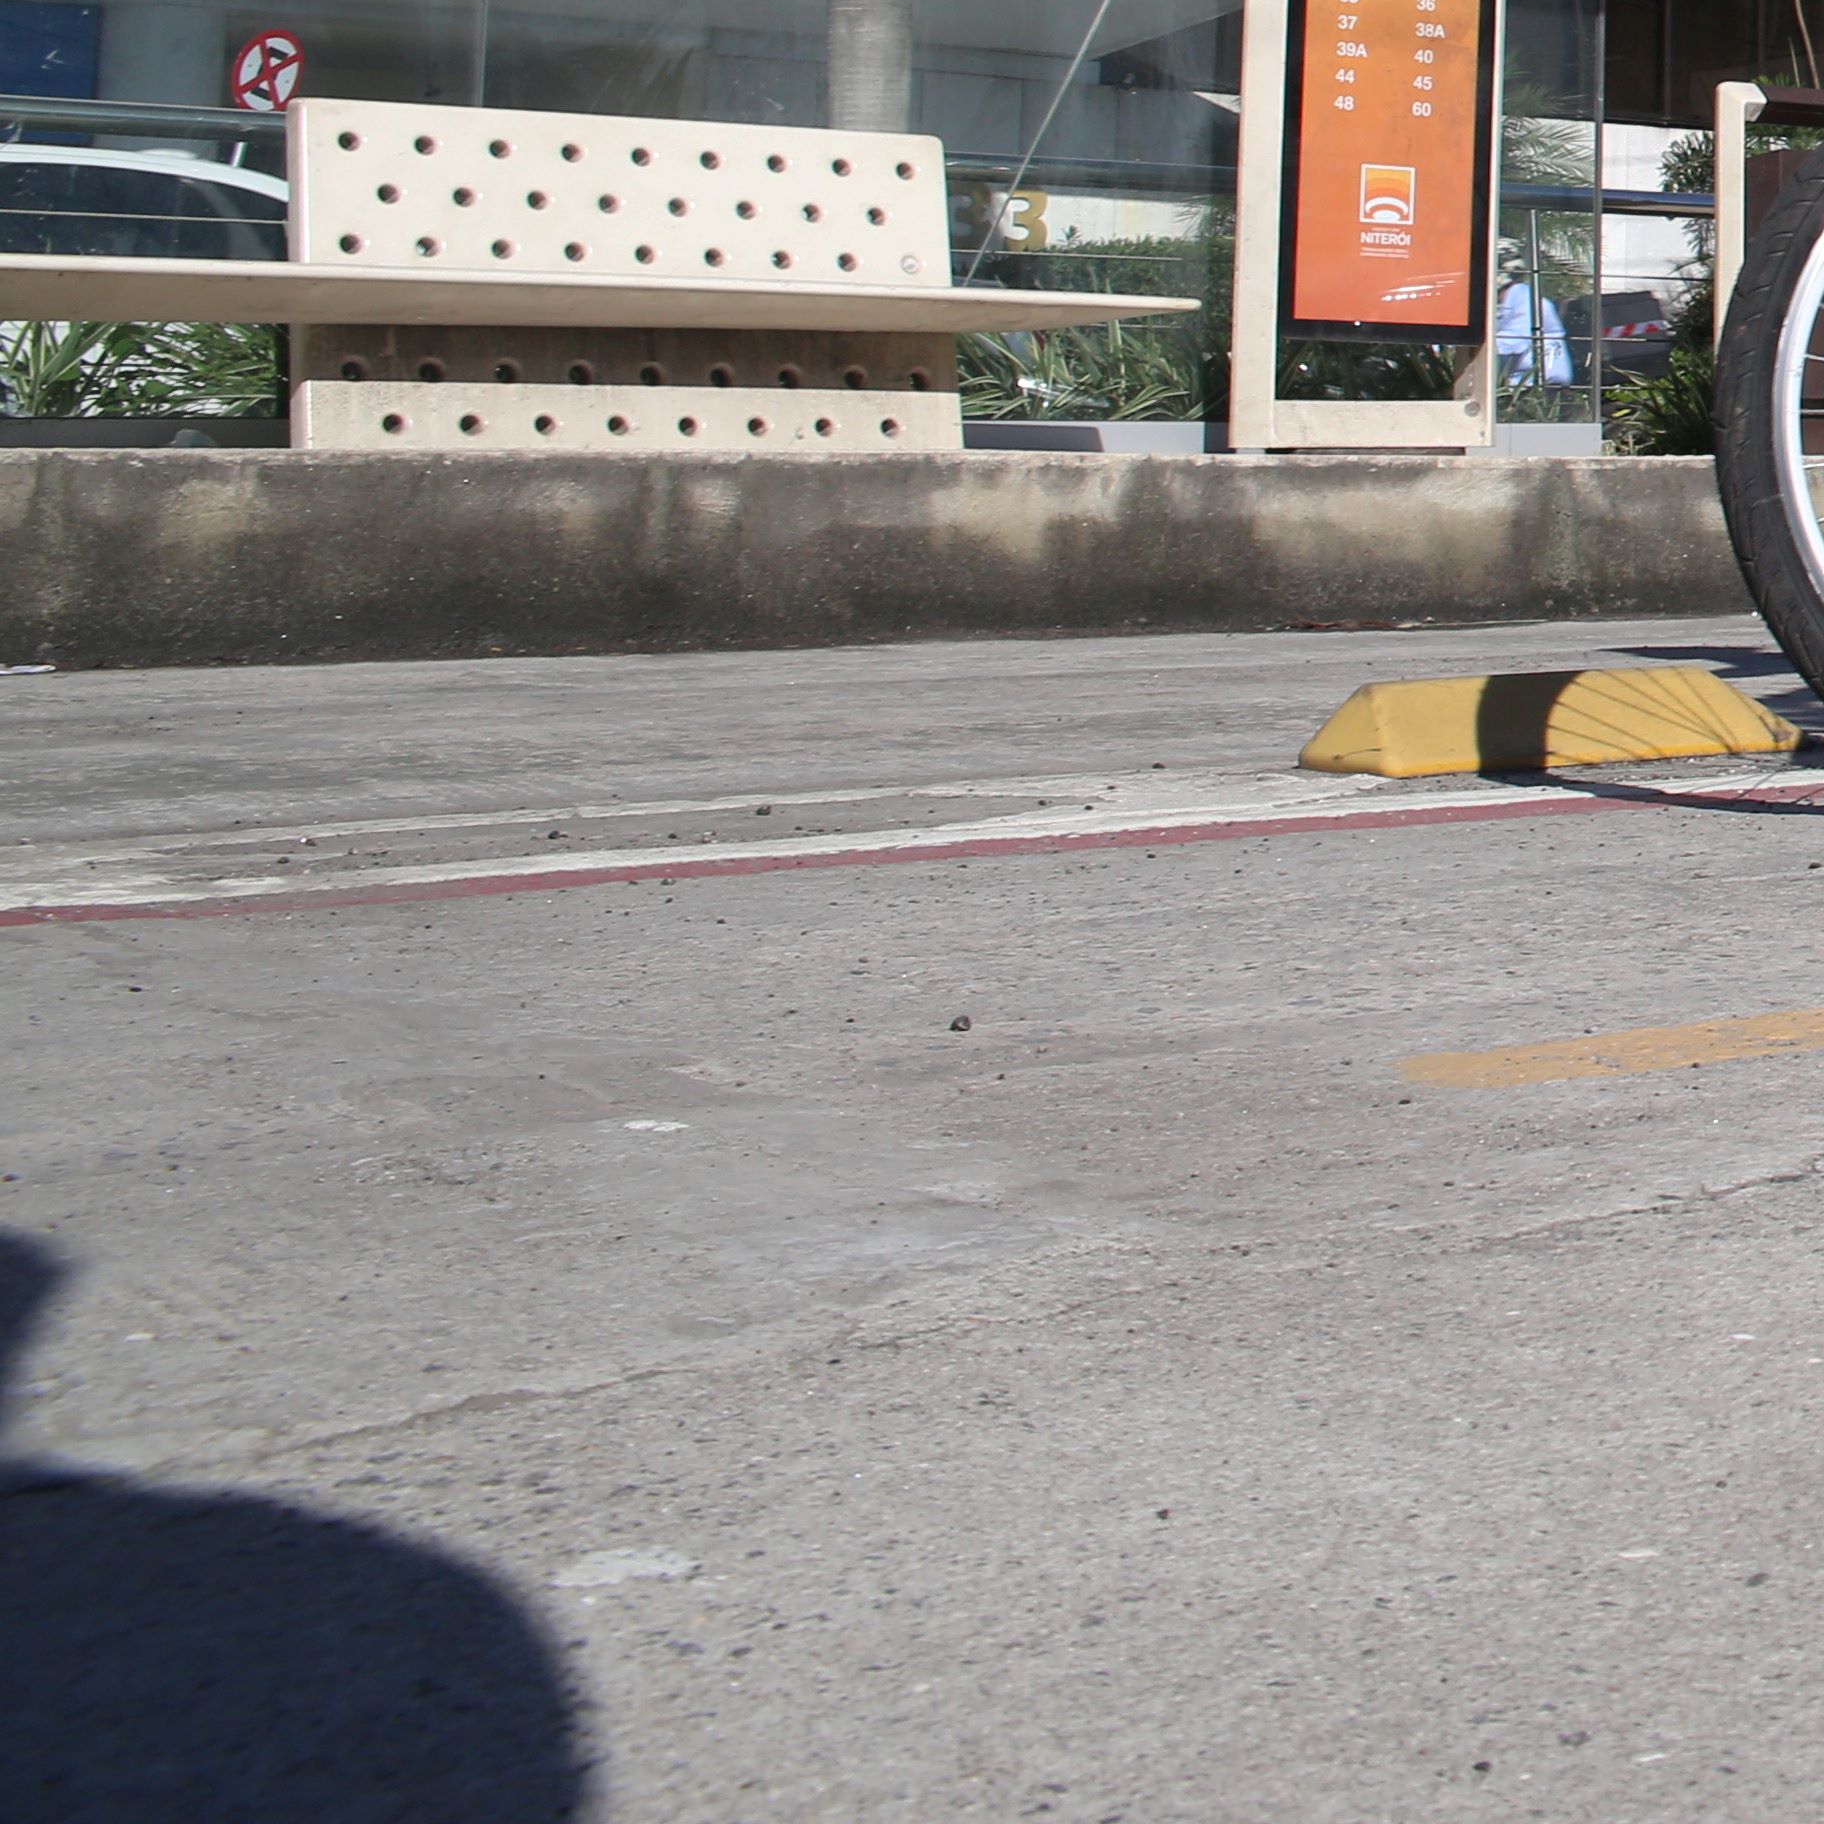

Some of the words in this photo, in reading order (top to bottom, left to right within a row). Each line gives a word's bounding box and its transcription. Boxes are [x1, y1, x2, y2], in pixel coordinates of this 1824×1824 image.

[1337, 14, 1358, 30] 37
[1415, 22, 1446, 38] 38A
[1336, 41, 1368, 58] 39A
[1414, 49, 1434, 64] 40
[1335, 68, 1355, 84] 44
[1412, 75, 1433, 91] 45
[1334, 95, 1354, 111] 48
[1412, 101, 1432, 117] 60
[1360, 231, 1411, 246] NITERÓI
